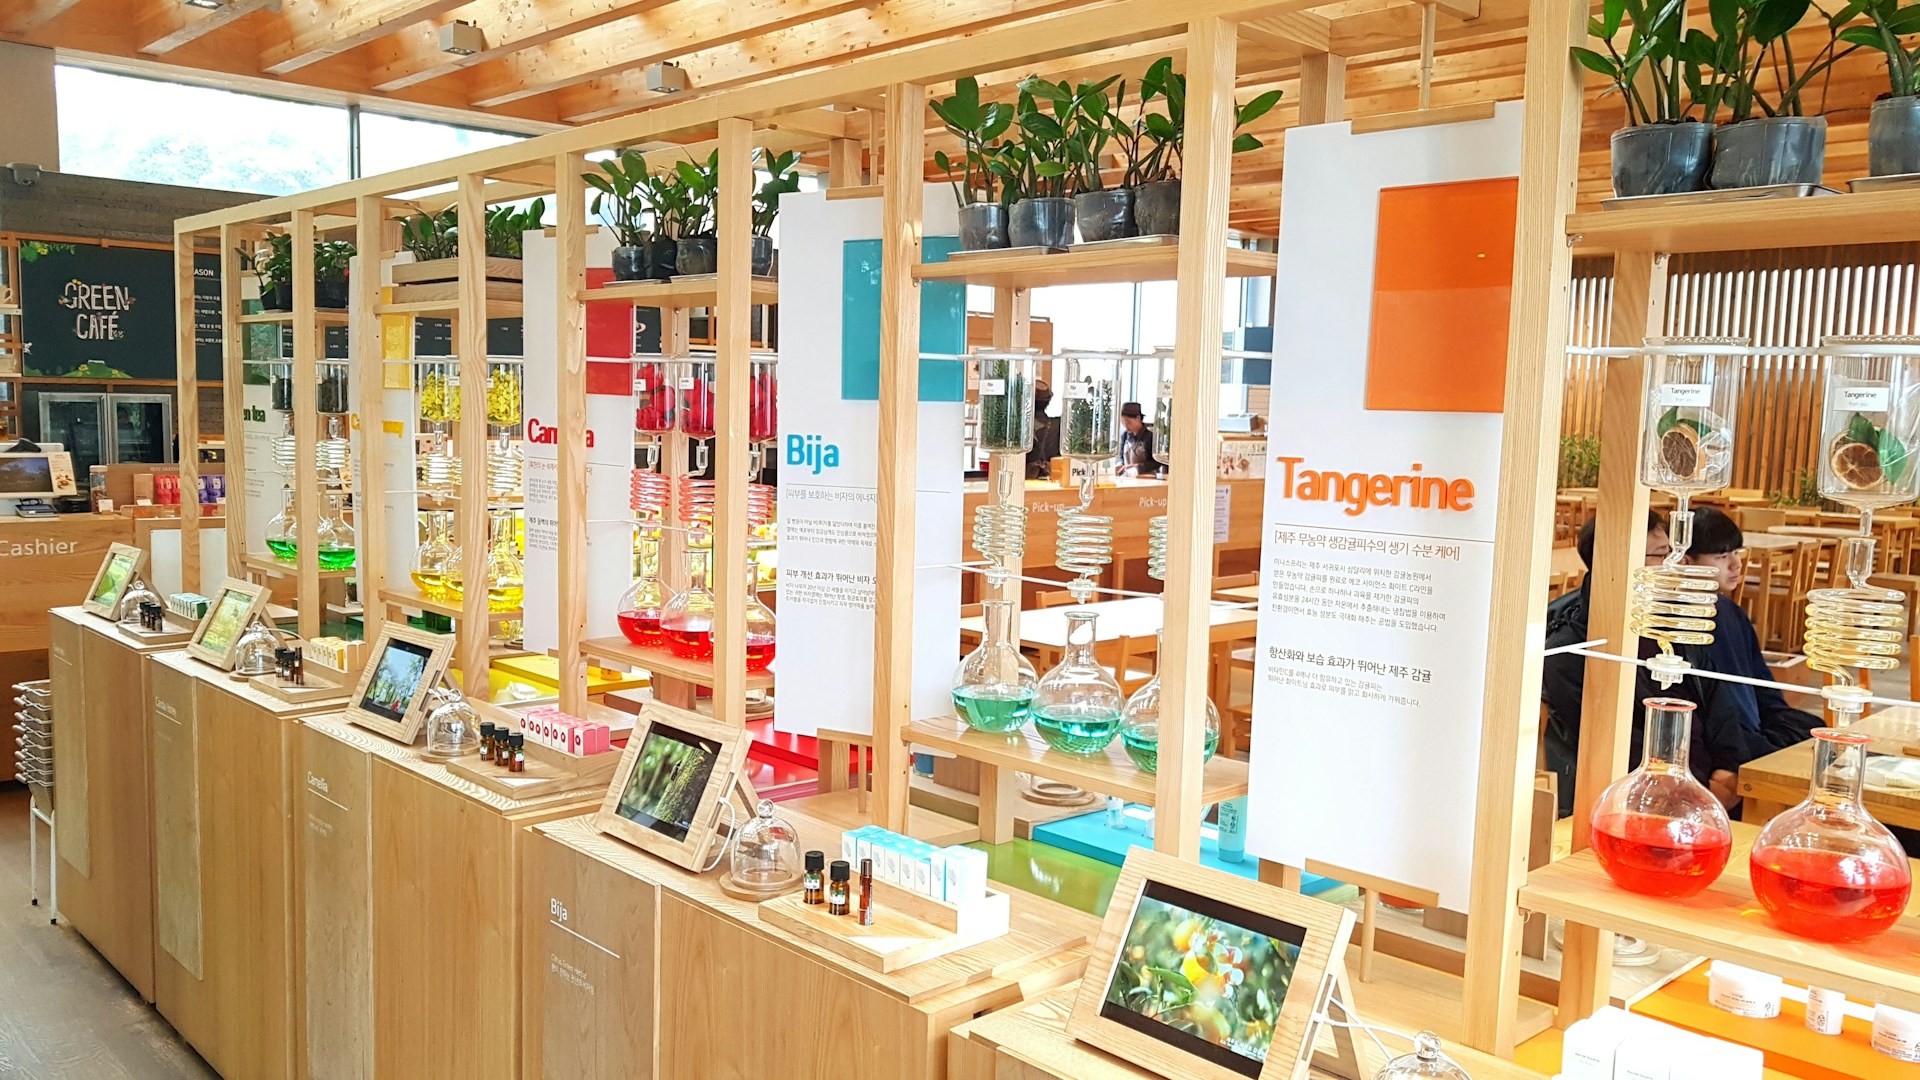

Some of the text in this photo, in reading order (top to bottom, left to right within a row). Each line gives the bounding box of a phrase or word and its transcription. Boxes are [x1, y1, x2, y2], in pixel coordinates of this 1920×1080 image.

[194, 269, 214, 277] ASON
[64, 281, 129, 310] GREEN
[76, 311, 119, 340] CAFÉ
[1671, 387, 1701, 395] Tangerine
[1844, 391, 1877, 399] Tangerine
[786, 434, 840, 475] Bija
[1275, 456, 1475, 517] Tangerine
[834, 492, 855, 502] 비자의
[1139, 496, 1168, 508] Pick-up
[1032, 502, 1065, 513] Pick-up
[0, 538, 78, 557] Cashier
[1274, 530, 1296, 544] [제주
[1298, 533, 1327, 548] 무농약
[1388, 542, 1409, 556] 생기
[1411, 544, 1433, 558] 수분
[1435, 546, 1460, 561] 케어]
[786, 569, 798, 578] 피부
[800, 570, 813, 580] 개선
[815, 571, 834, 582] 효과가
[836, 573, 855, 584] 뛰어난
[857, 576, 870, 585] 비자
[1269, 646, 1432, 684] 항산화와 보습 효과가 뛰어난 제주 감귤
[550, 897, 568, 922] Bija
